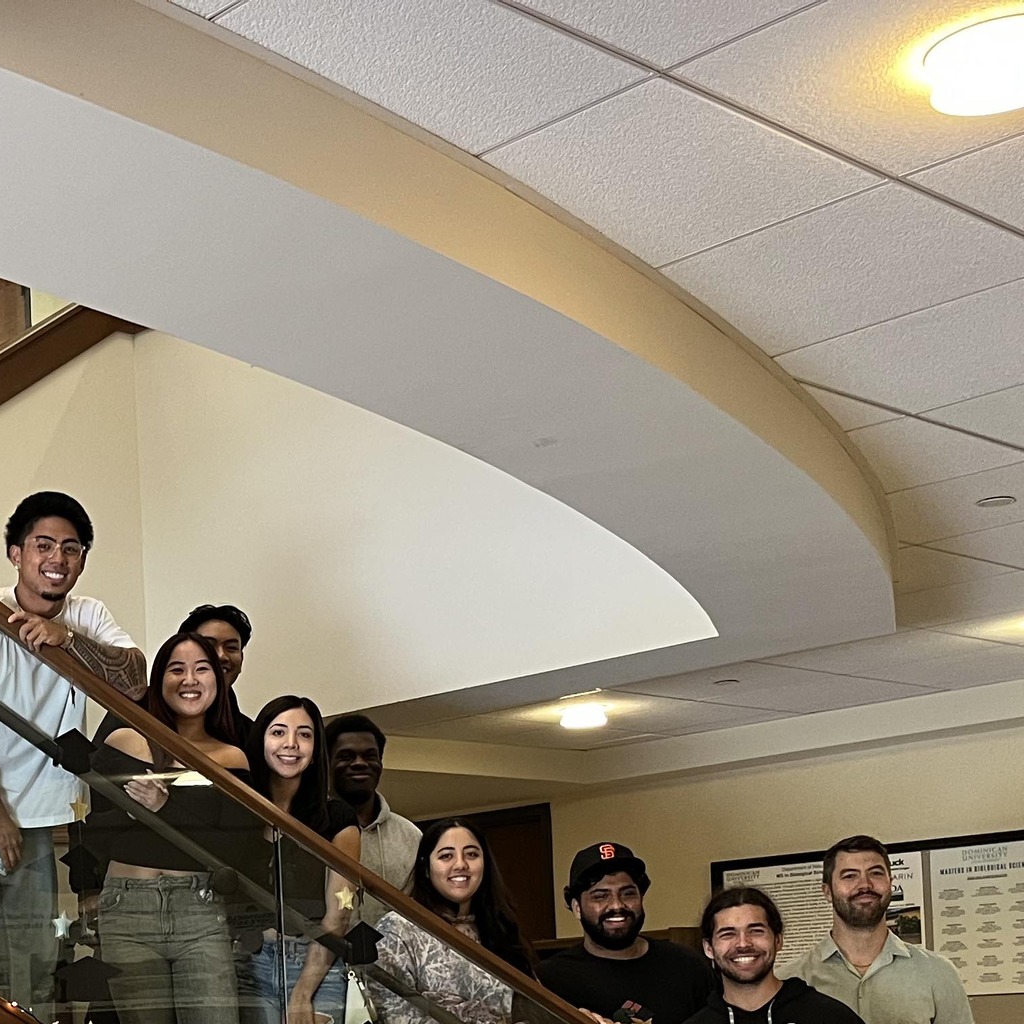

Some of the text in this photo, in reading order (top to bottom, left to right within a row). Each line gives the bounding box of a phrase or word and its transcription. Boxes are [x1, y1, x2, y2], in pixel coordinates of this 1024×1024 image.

[962, 846, 1008, 856] DOMINICAN
[962, 852, 1008, 862] UNIVERSITY
[890, 858, 904, 867] uck
[1009, 861, 1024, 869] SCIEN
